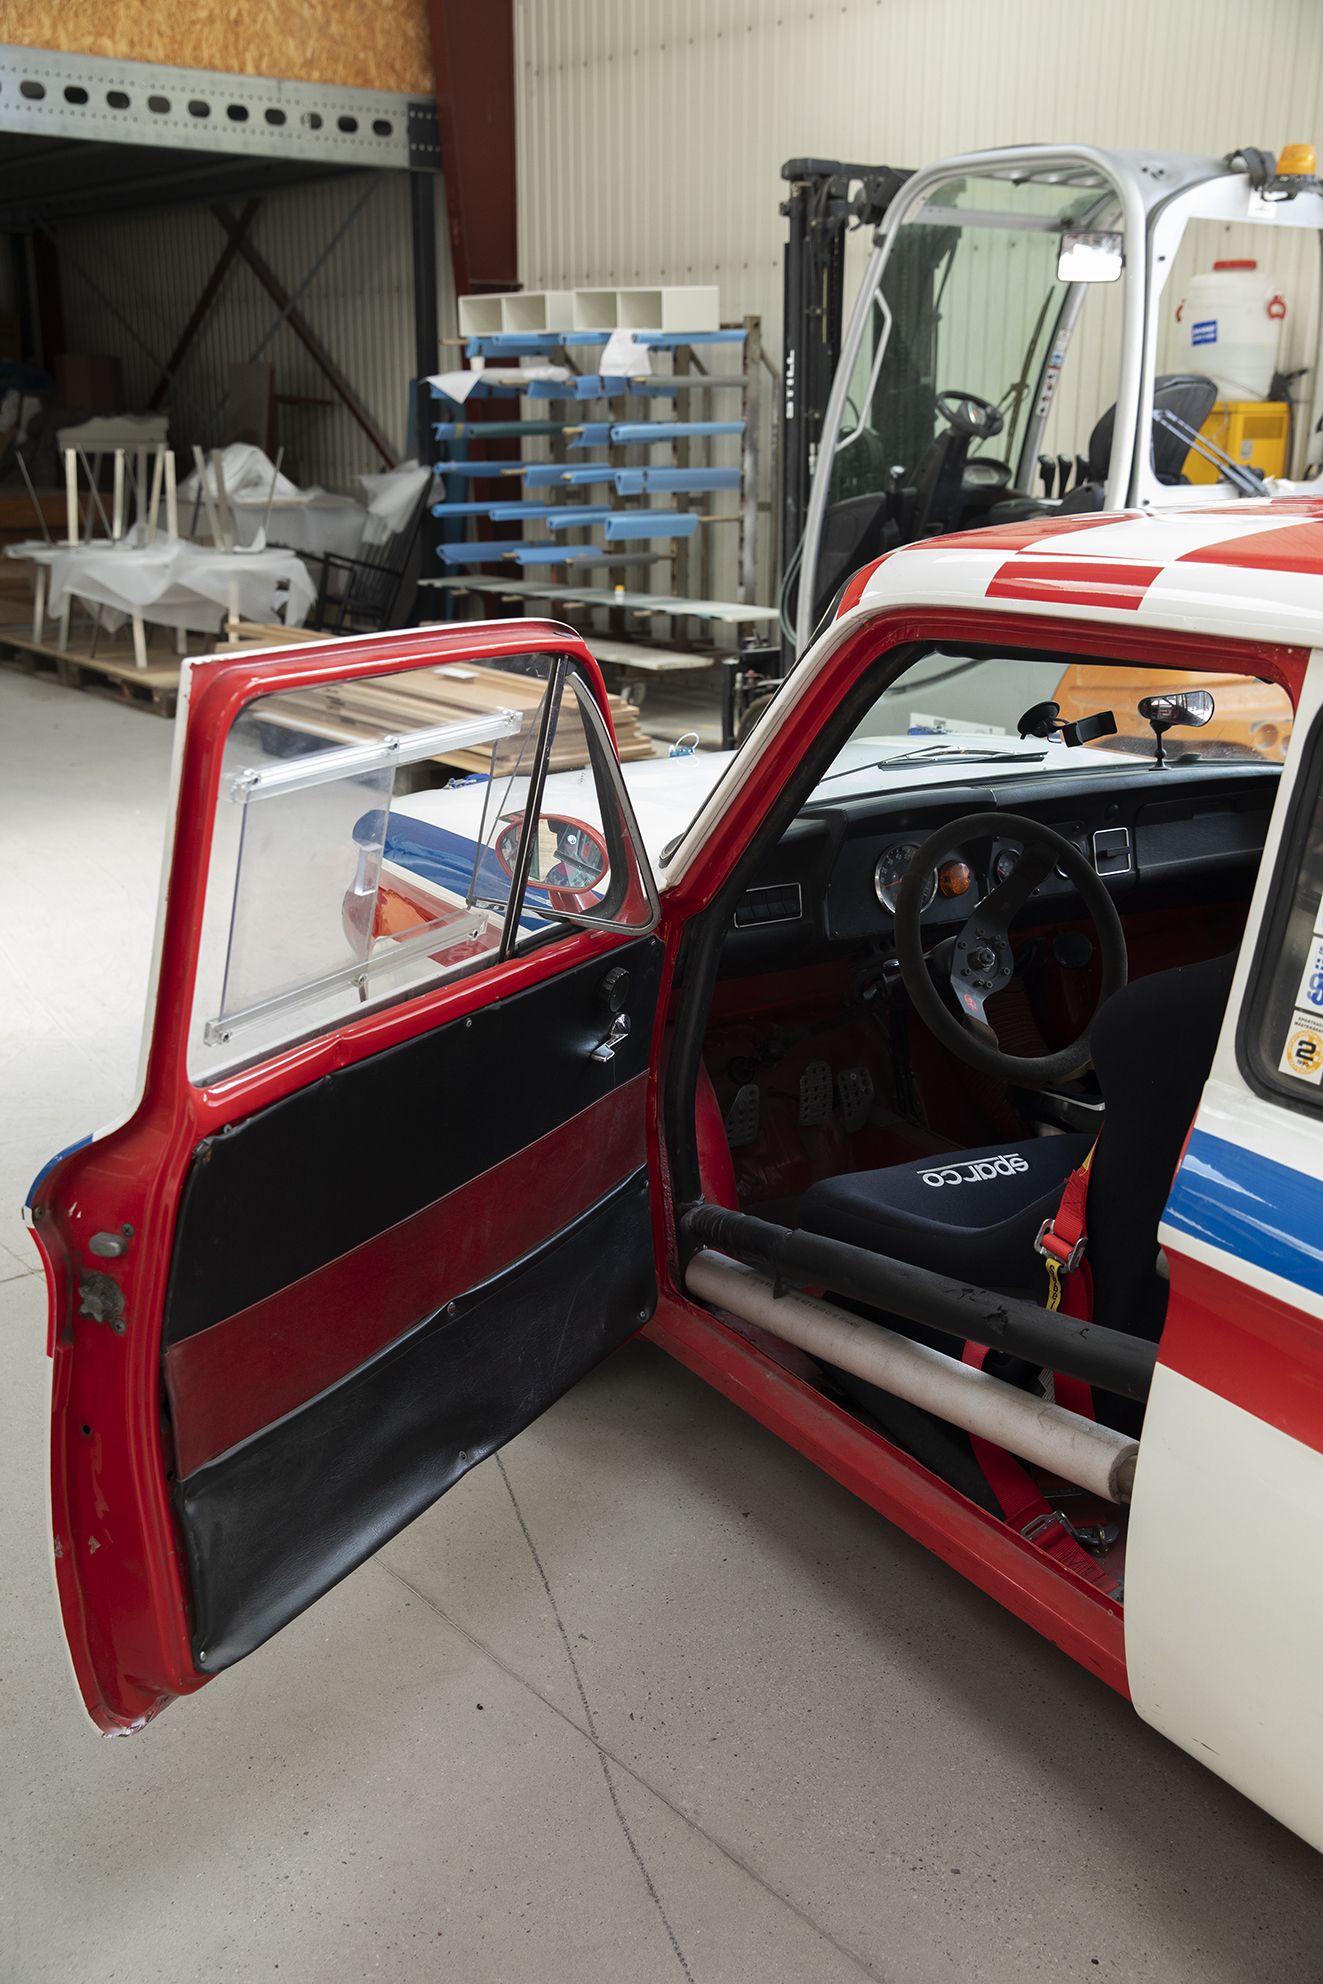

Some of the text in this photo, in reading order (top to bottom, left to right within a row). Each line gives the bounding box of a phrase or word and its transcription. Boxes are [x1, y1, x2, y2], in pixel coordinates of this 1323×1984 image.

[786, 349, 795, 419] STILL
[1296, 1040, 1316, 1062] 2
[918, 1154, 1029, 1187] sparco
